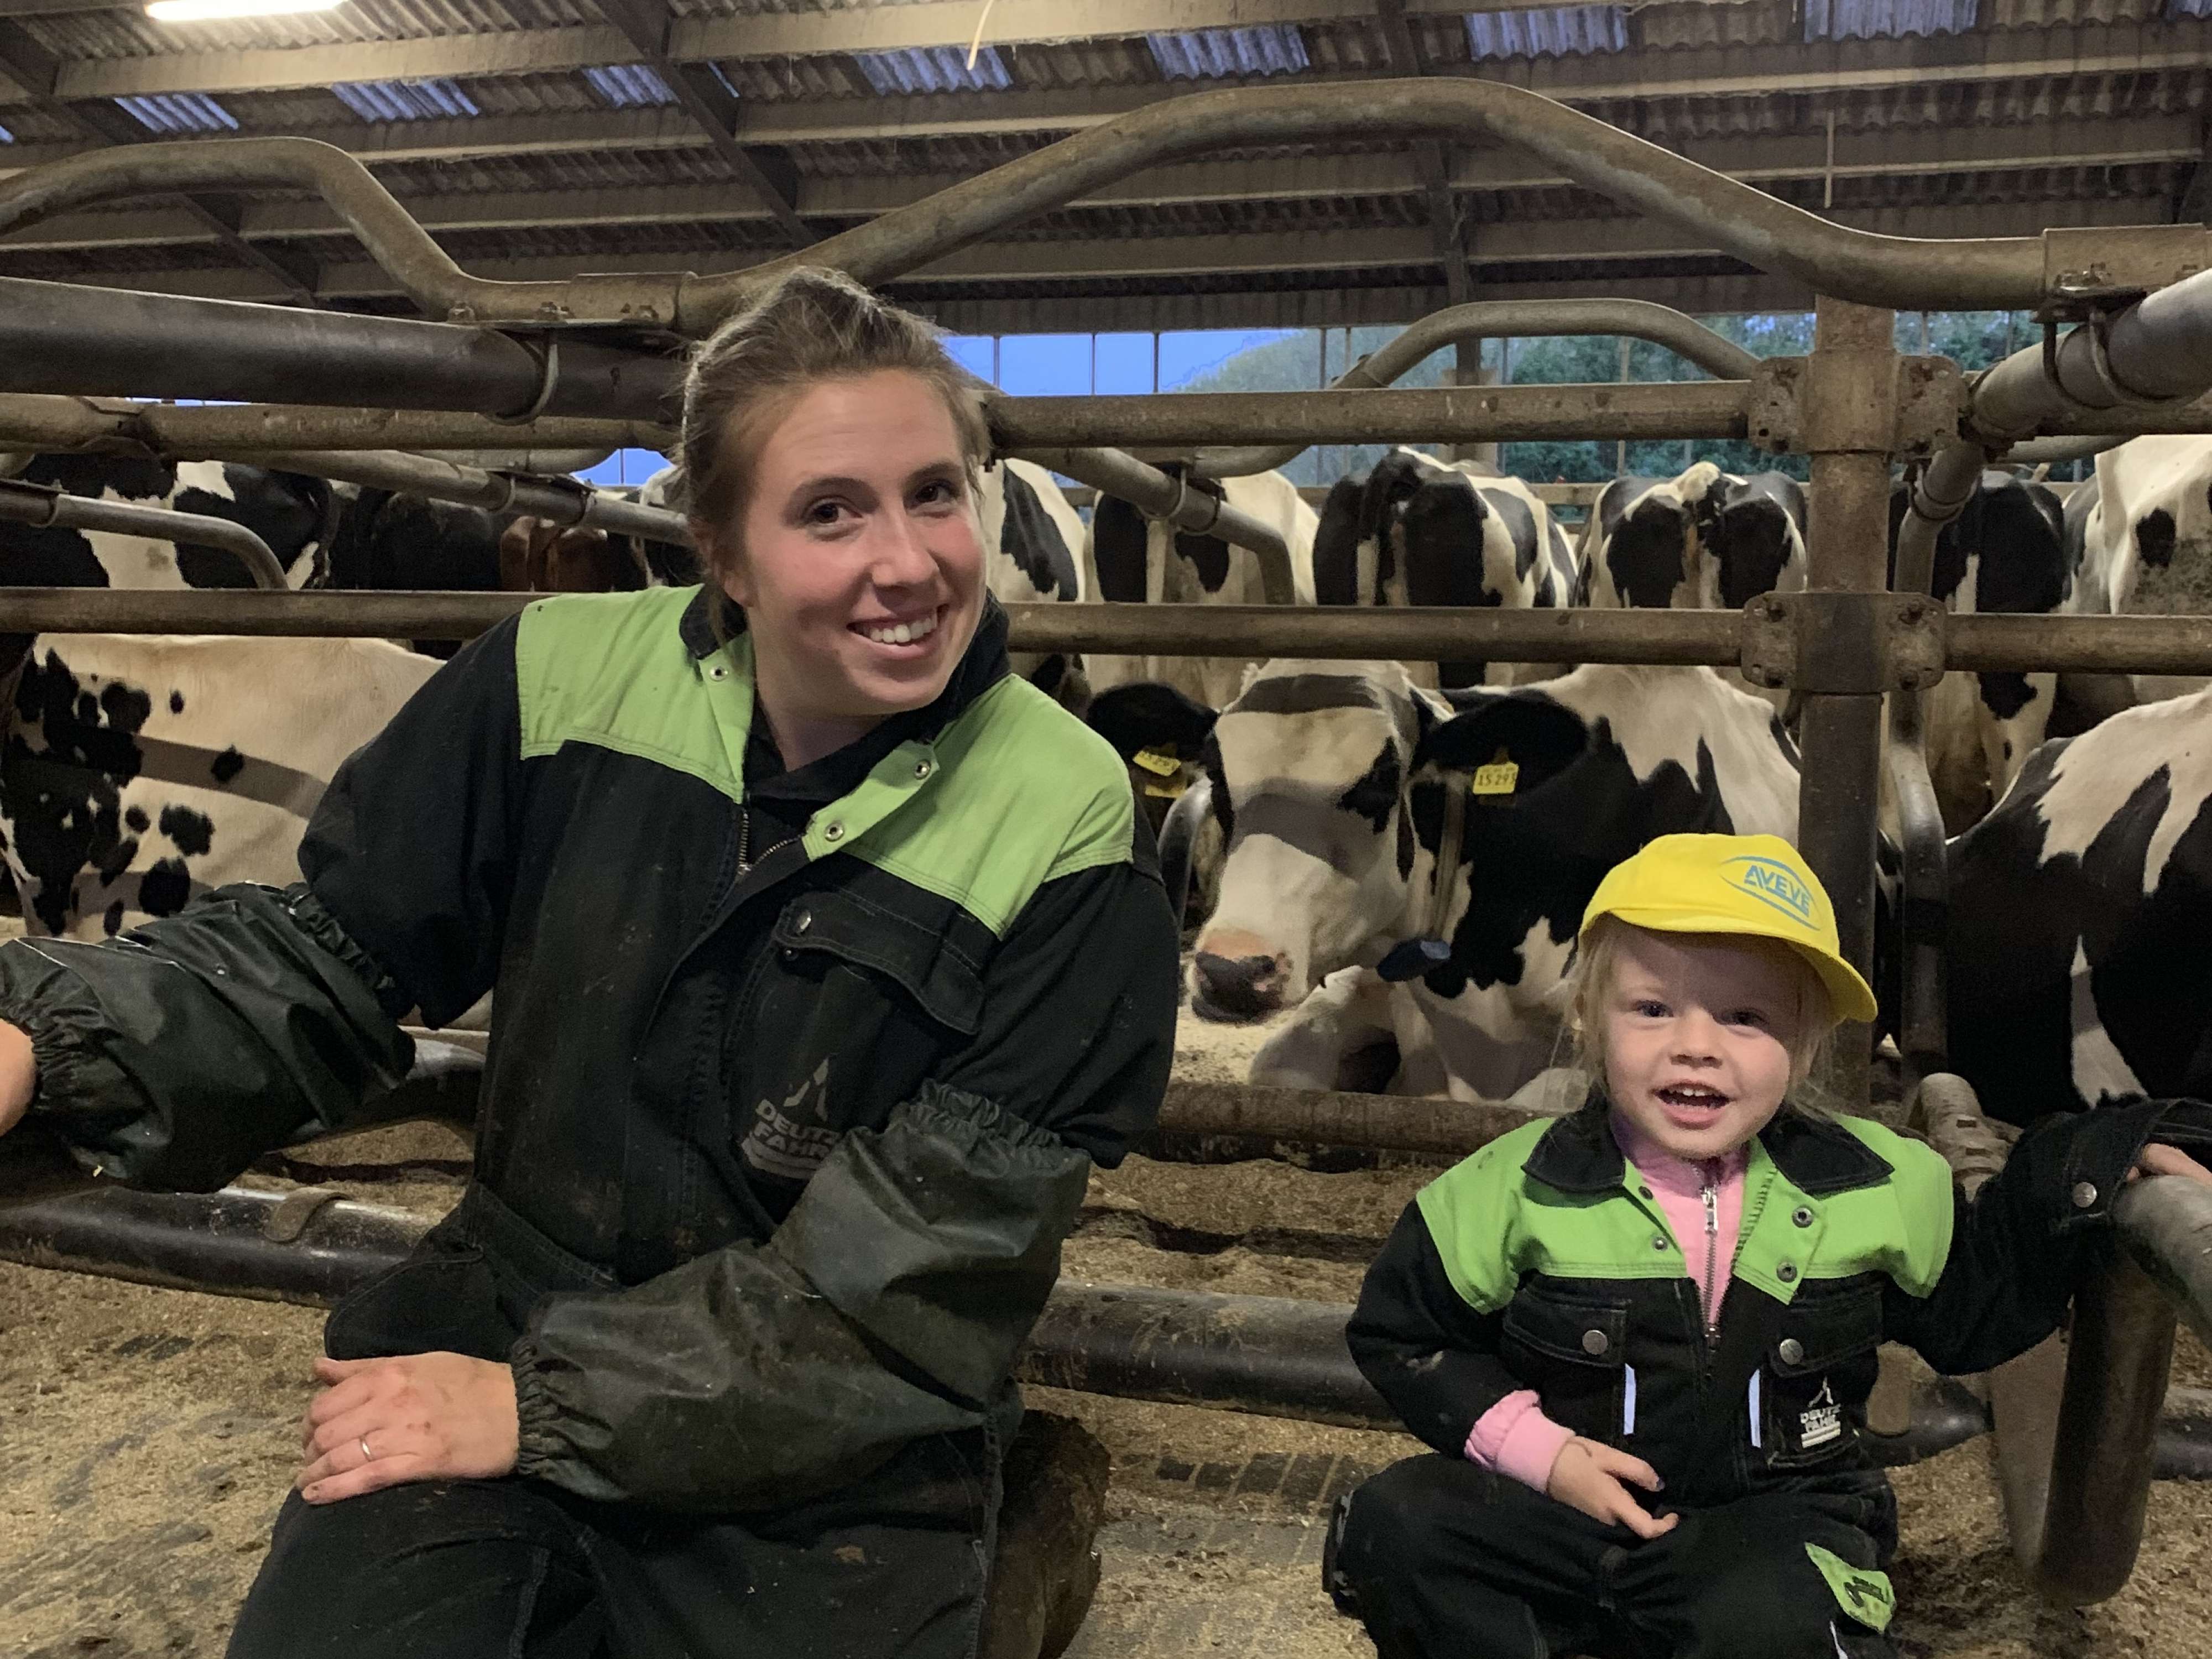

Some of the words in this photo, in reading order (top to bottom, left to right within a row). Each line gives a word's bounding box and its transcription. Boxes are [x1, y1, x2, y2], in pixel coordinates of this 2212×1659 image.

[1744, 865, 1809, 914] AVEVE
[753, 1120, 831, 1158] FAHR
[755, 1098, 841, 1146] DEUTZ
